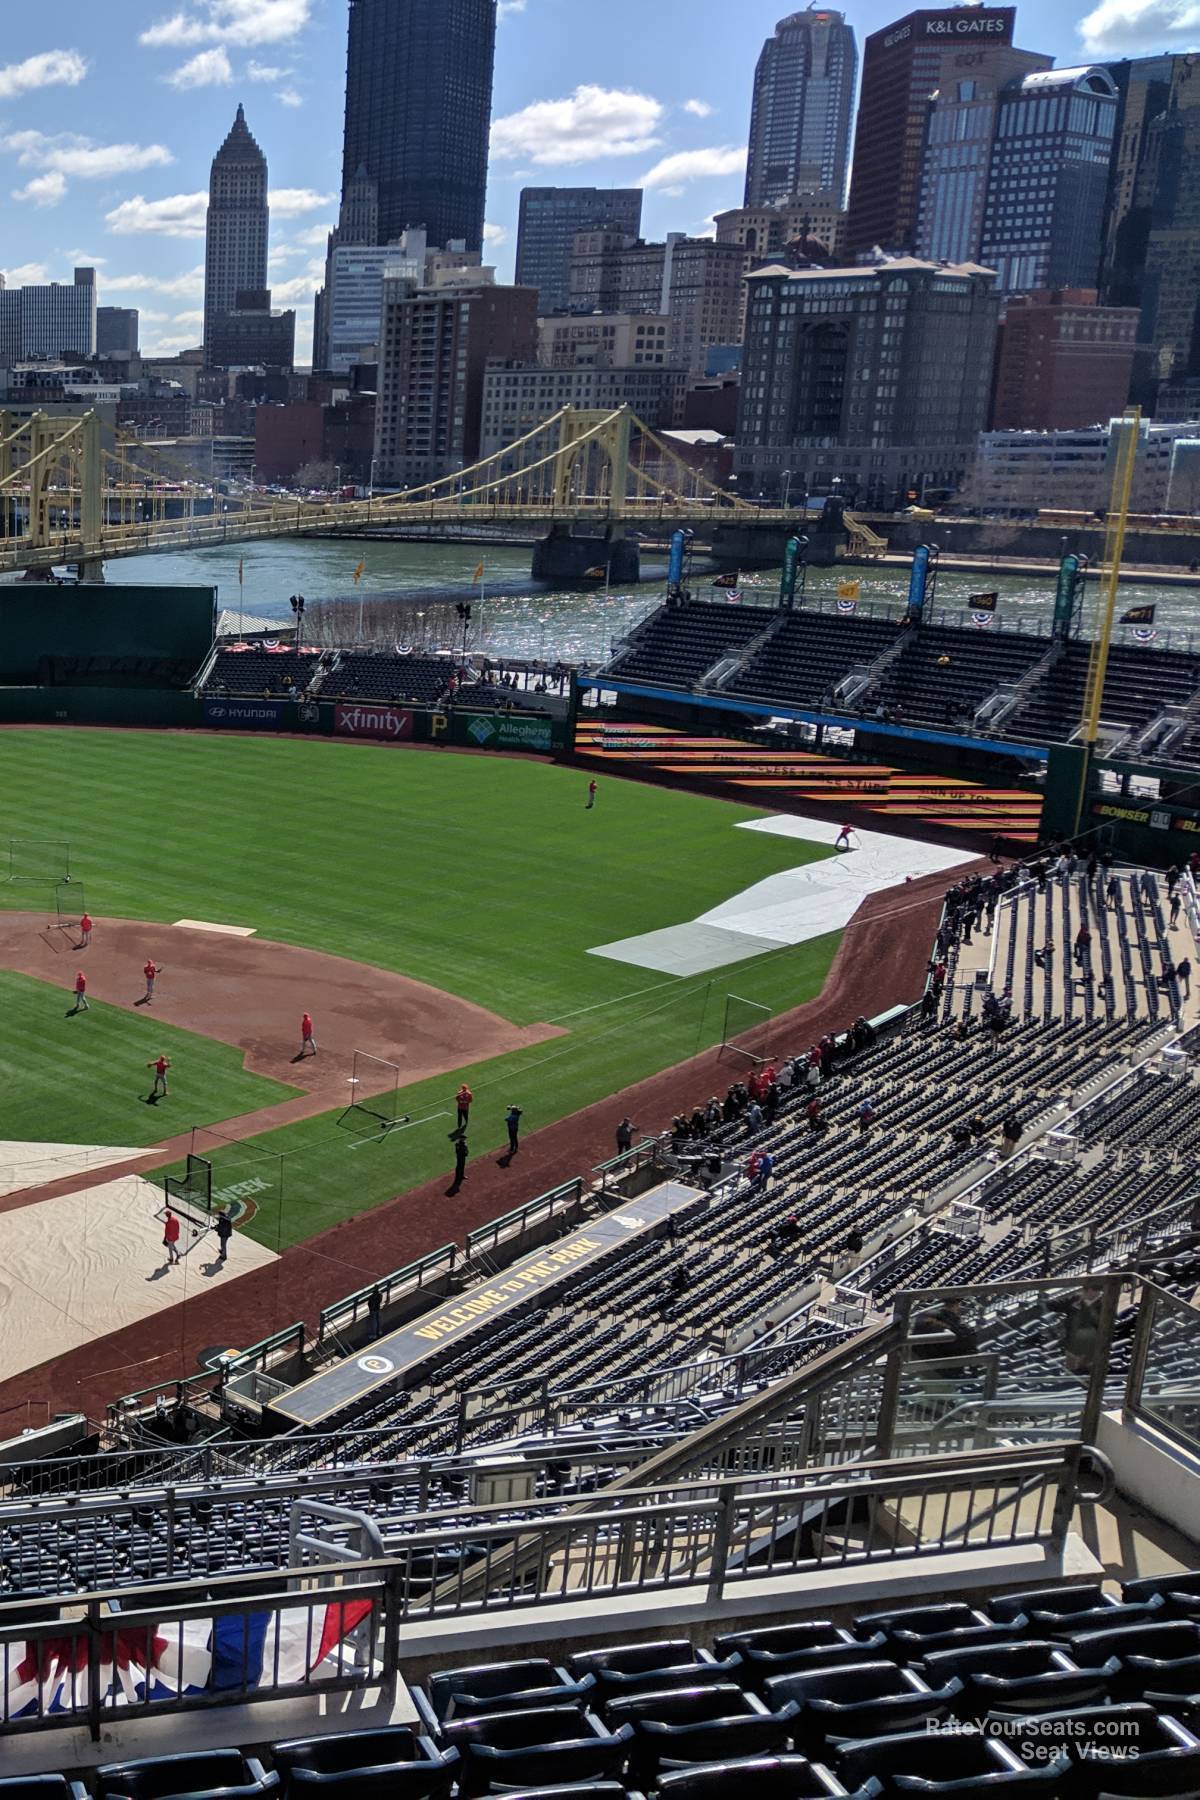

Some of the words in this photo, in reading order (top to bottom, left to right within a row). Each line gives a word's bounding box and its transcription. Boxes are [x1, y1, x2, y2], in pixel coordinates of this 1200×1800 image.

[926, 20, 953, 33] K&L
[956, 19, 1005, 33] GATES
[228, 709, 277, 719] HYUNDAI
[340, 708, 407, 735] xfinity
[431, 714, 448, 738] P
[498, 723, 552, 737] Allegheny
[1100, 804, 1150, 823] BOWSER
[413, 1289, 510, 1341] WELCOME
[500, 1280, 522, 1292] TO
[517, 1260, 561, 1283] PNC
[552, 1237, 602, 1265] PARK
